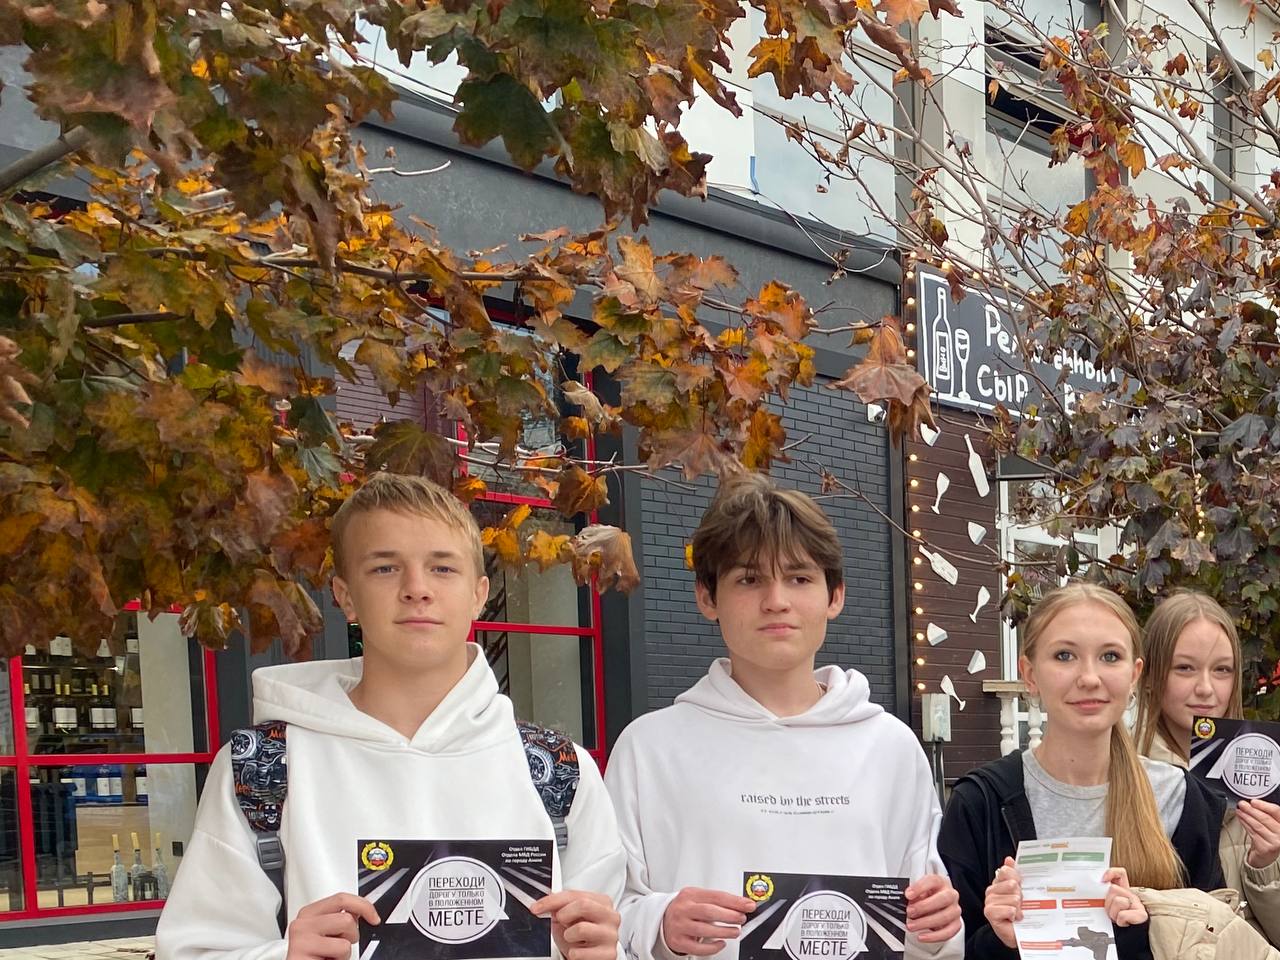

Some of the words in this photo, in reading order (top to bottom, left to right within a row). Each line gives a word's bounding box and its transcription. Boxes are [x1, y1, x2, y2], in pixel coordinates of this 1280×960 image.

[977, 364, 1029, 404] Сыр
[1235, 747, 1273, 759] ПЕРЕХОДИ
[1233, 772, 1271, 787] МЕСТЕ
[741, 794, 777, 805] raised
[815, 795, 850, 806] streets
[429, 876, 485, 889] ПЕРЕХОДИ
[429, 891, 456, 899] ДОРОГУ
[458, 890, 485, 898] ТОЛЬКО
[428, 899, 434, 907] В
[435, 898, 484, 907] ПОЛОЖЕННОМ
[428, 909, 484, 927] МЕСТЕ
[802, 908, 851, 920] ПЕРЕХОДИ
[799, 940, 848, 956] МЕСТЕ
